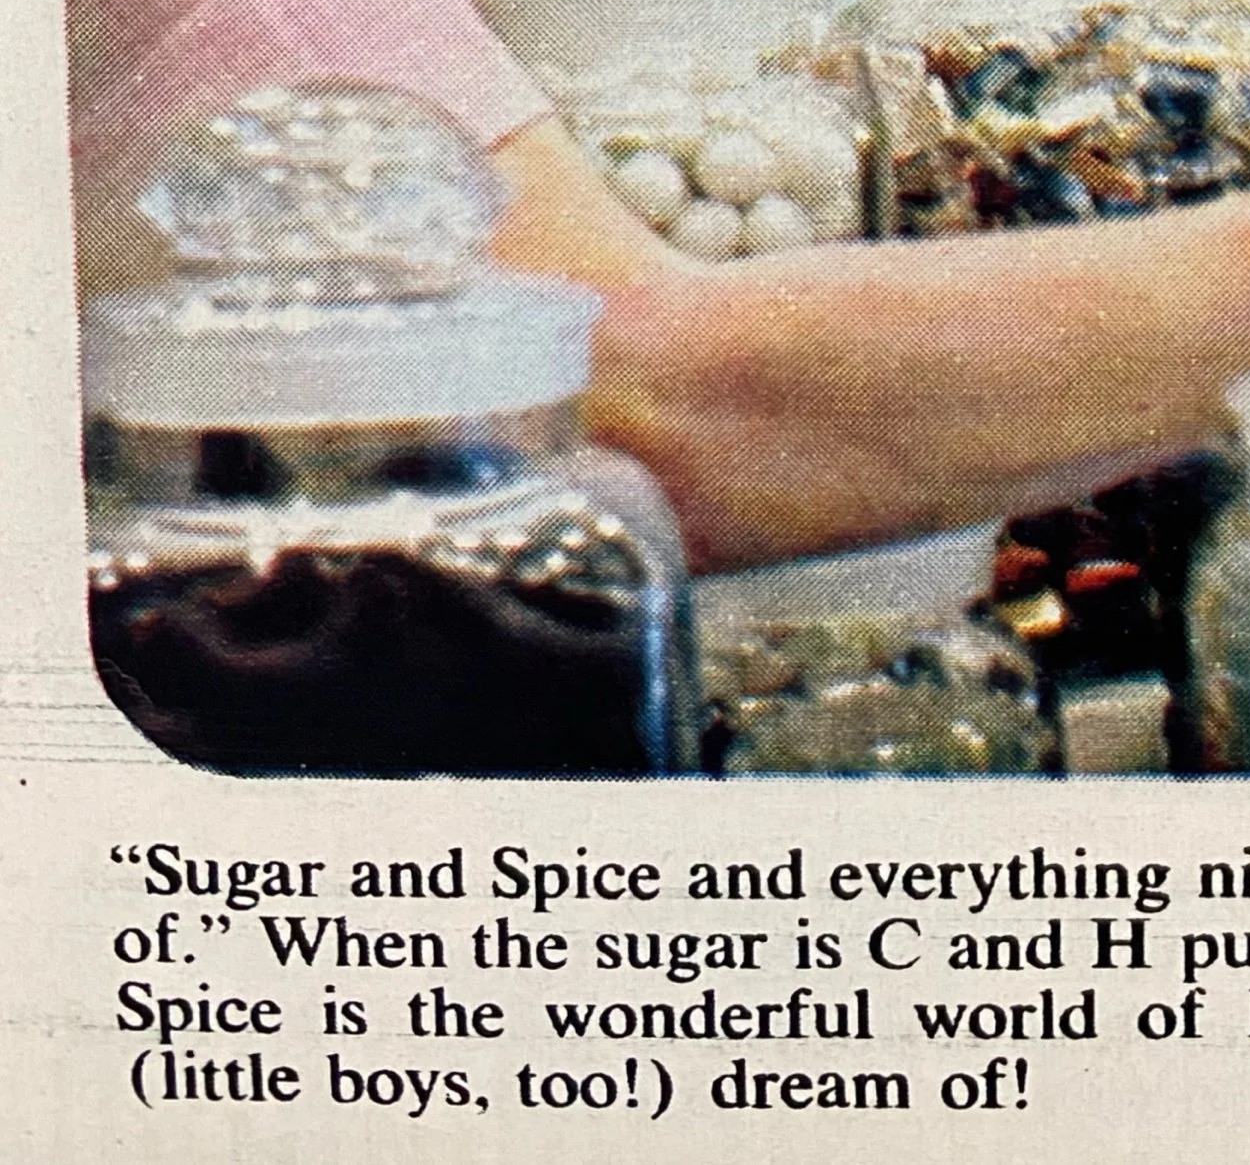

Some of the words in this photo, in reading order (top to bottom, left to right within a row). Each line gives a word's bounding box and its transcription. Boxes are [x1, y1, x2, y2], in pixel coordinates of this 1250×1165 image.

[110, 843, 326, 911] “Sugar
[350, 847, 467, 899] and
[491, 846, 661, 914] Spice
[688, 848, 807, 900] and
[829, 846, 1171, 915] everything
[113, 912, 231, 969] of.”
[258, 915, 448, 969] When
[471, 916, 568, 971] the
[595, 933, 768, 984] sugar
[795, 917, 842, 970] is
[868, 917, 921, 971] C
[947, 918, 1065, 971] and
[1090, 917, 1152, 970] H
[116, 980, 282, 1045] Spice
[323, 984, 368, 1036] is
[407, 986, 505, 1039] the
[545, 987, 874, 1041] wonderful
[913, 988, 1098, 1041] world
[1137, 986, 1207, 1041] of
[131, 1049, 301, 1109] (little
[326, 1053, 489, 1119] boys,
[516, 1057, 673, 1121] too!)
[710, 1058, 910, 1110] dream
[940, 1056, 1028, 1110] of!
